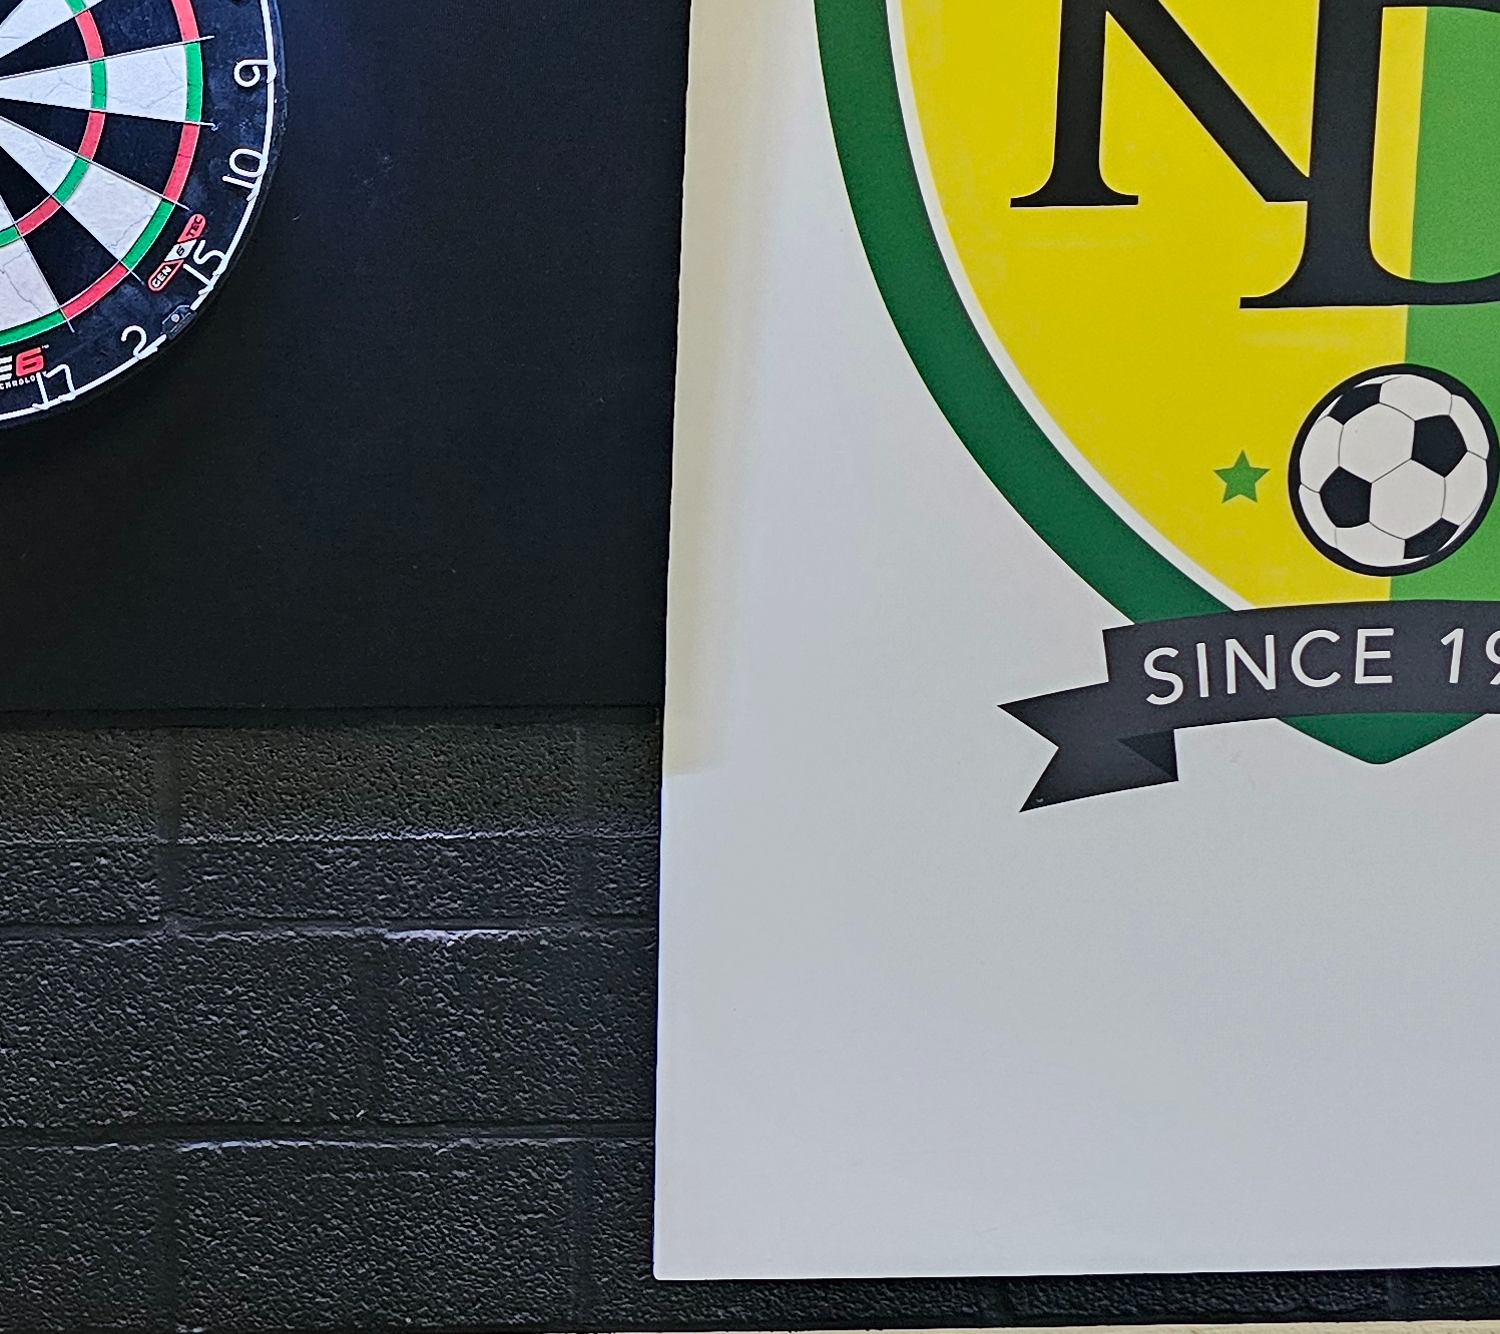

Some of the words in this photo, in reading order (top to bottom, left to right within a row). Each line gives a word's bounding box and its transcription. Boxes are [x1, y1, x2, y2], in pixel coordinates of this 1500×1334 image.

[222, 149, 267, 201] 10
[152, 265, 172, 288] GEN
[186, 216, 203, 237] TEC
[183, 240, 227, 295] 15
[121, 325, 158, 360] 2
[32, 364, 75, 410] 17
[1144, 627, 1394, 705] SINCE
